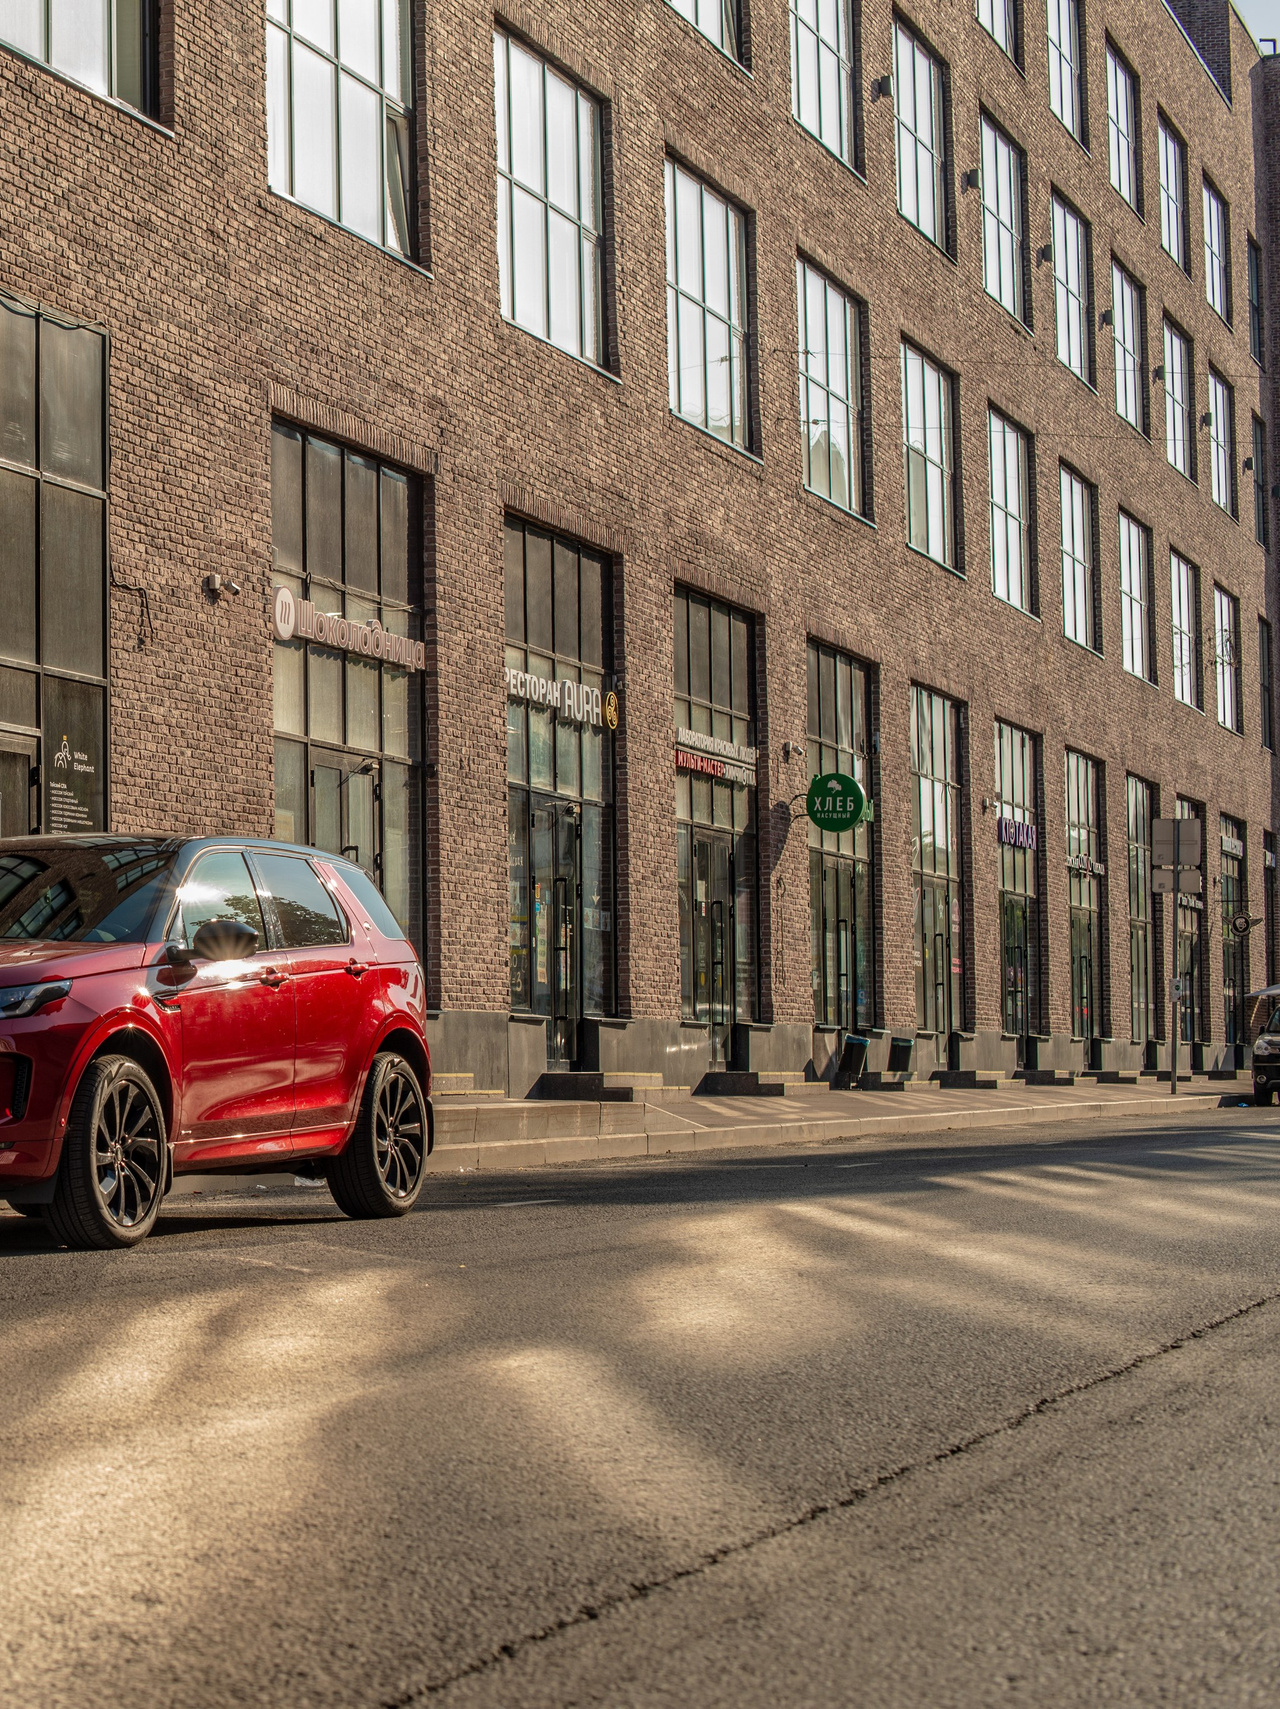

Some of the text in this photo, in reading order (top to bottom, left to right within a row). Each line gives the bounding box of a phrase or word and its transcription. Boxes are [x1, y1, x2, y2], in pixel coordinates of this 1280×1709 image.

[298, 599, 425, 672] Шоколадница
[563, 680, 602, 726] AURA
[74, 751, 88, 761] White
[74, 762, 94, 773] Elephant
[814, 797, 854, 811] ХЛЕБ
